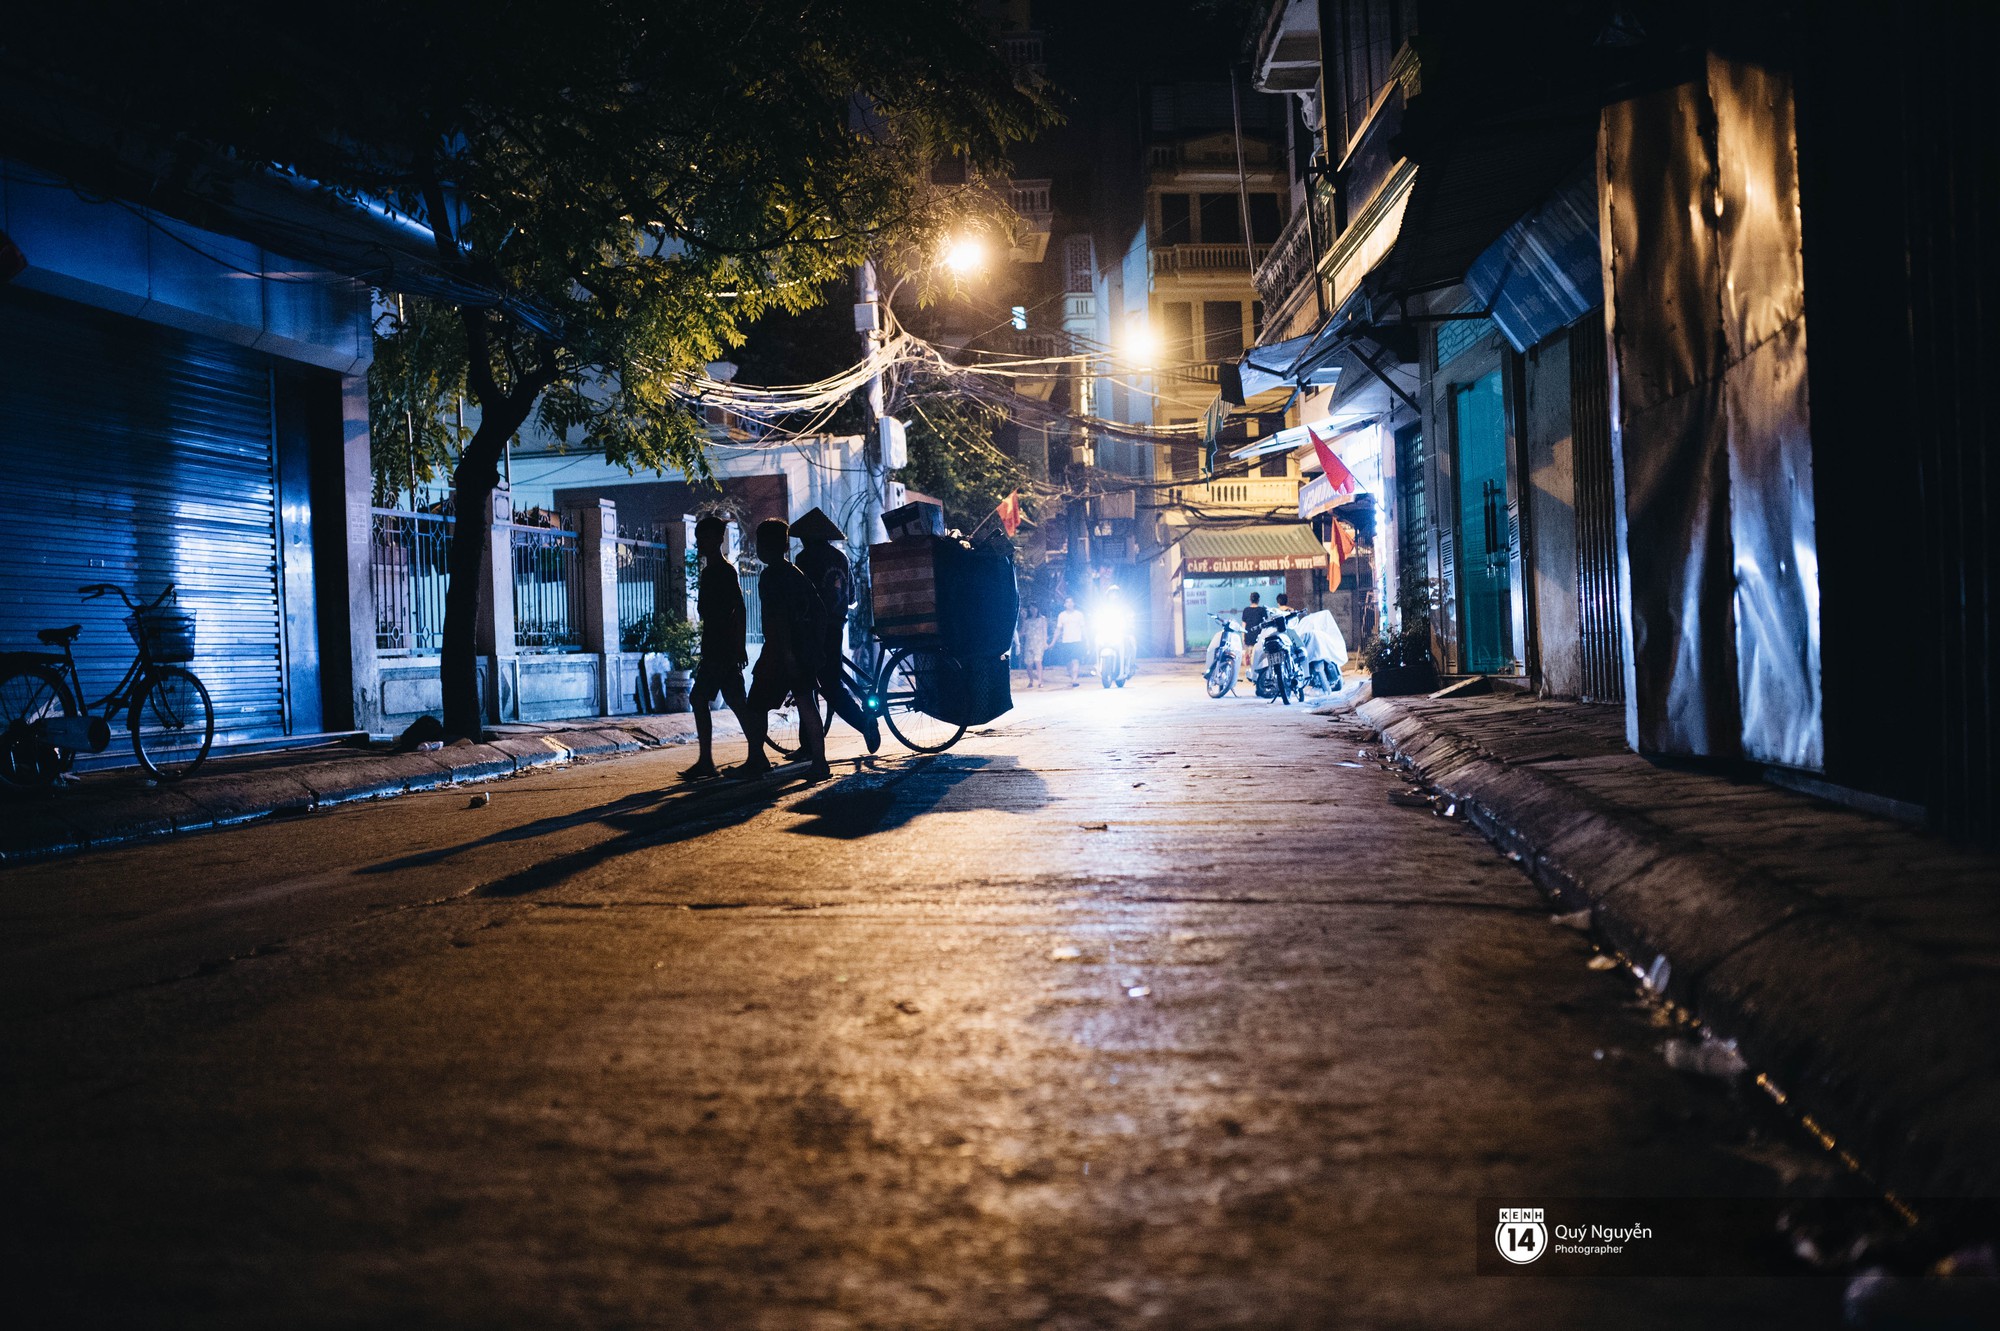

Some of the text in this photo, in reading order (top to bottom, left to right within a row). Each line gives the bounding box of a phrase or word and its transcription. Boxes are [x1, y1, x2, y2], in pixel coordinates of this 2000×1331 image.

[1232, 558, 1254, 571] KHÁT
[1259, 559, 1278, 571] SINH
[1279, 555, 1290, 570] TỐ
[1294, 558, 1313, 569] WIFI
